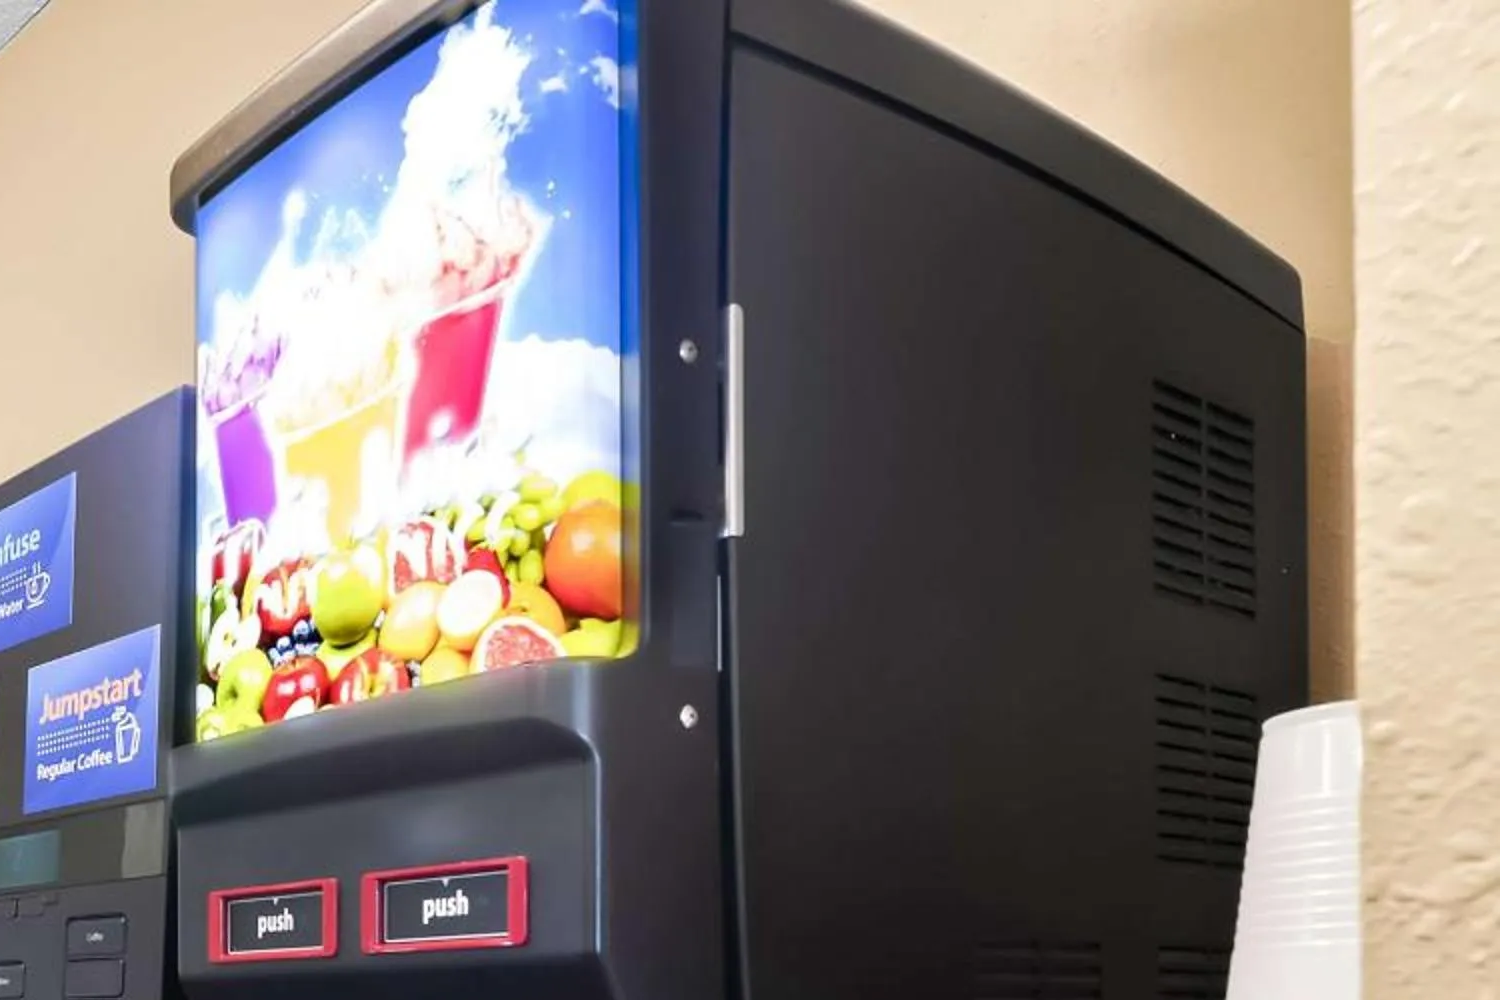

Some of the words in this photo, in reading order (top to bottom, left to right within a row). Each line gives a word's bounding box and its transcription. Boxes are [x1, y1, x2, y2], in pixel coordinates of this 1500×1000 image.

[38, 667, 143, 726] Jumpstart
[36, 753, 75, 783] Regular
[77, 748, 113, 772] Coffee
[257, 908, 295, 939] push
[422, 889, 469, 925] push
